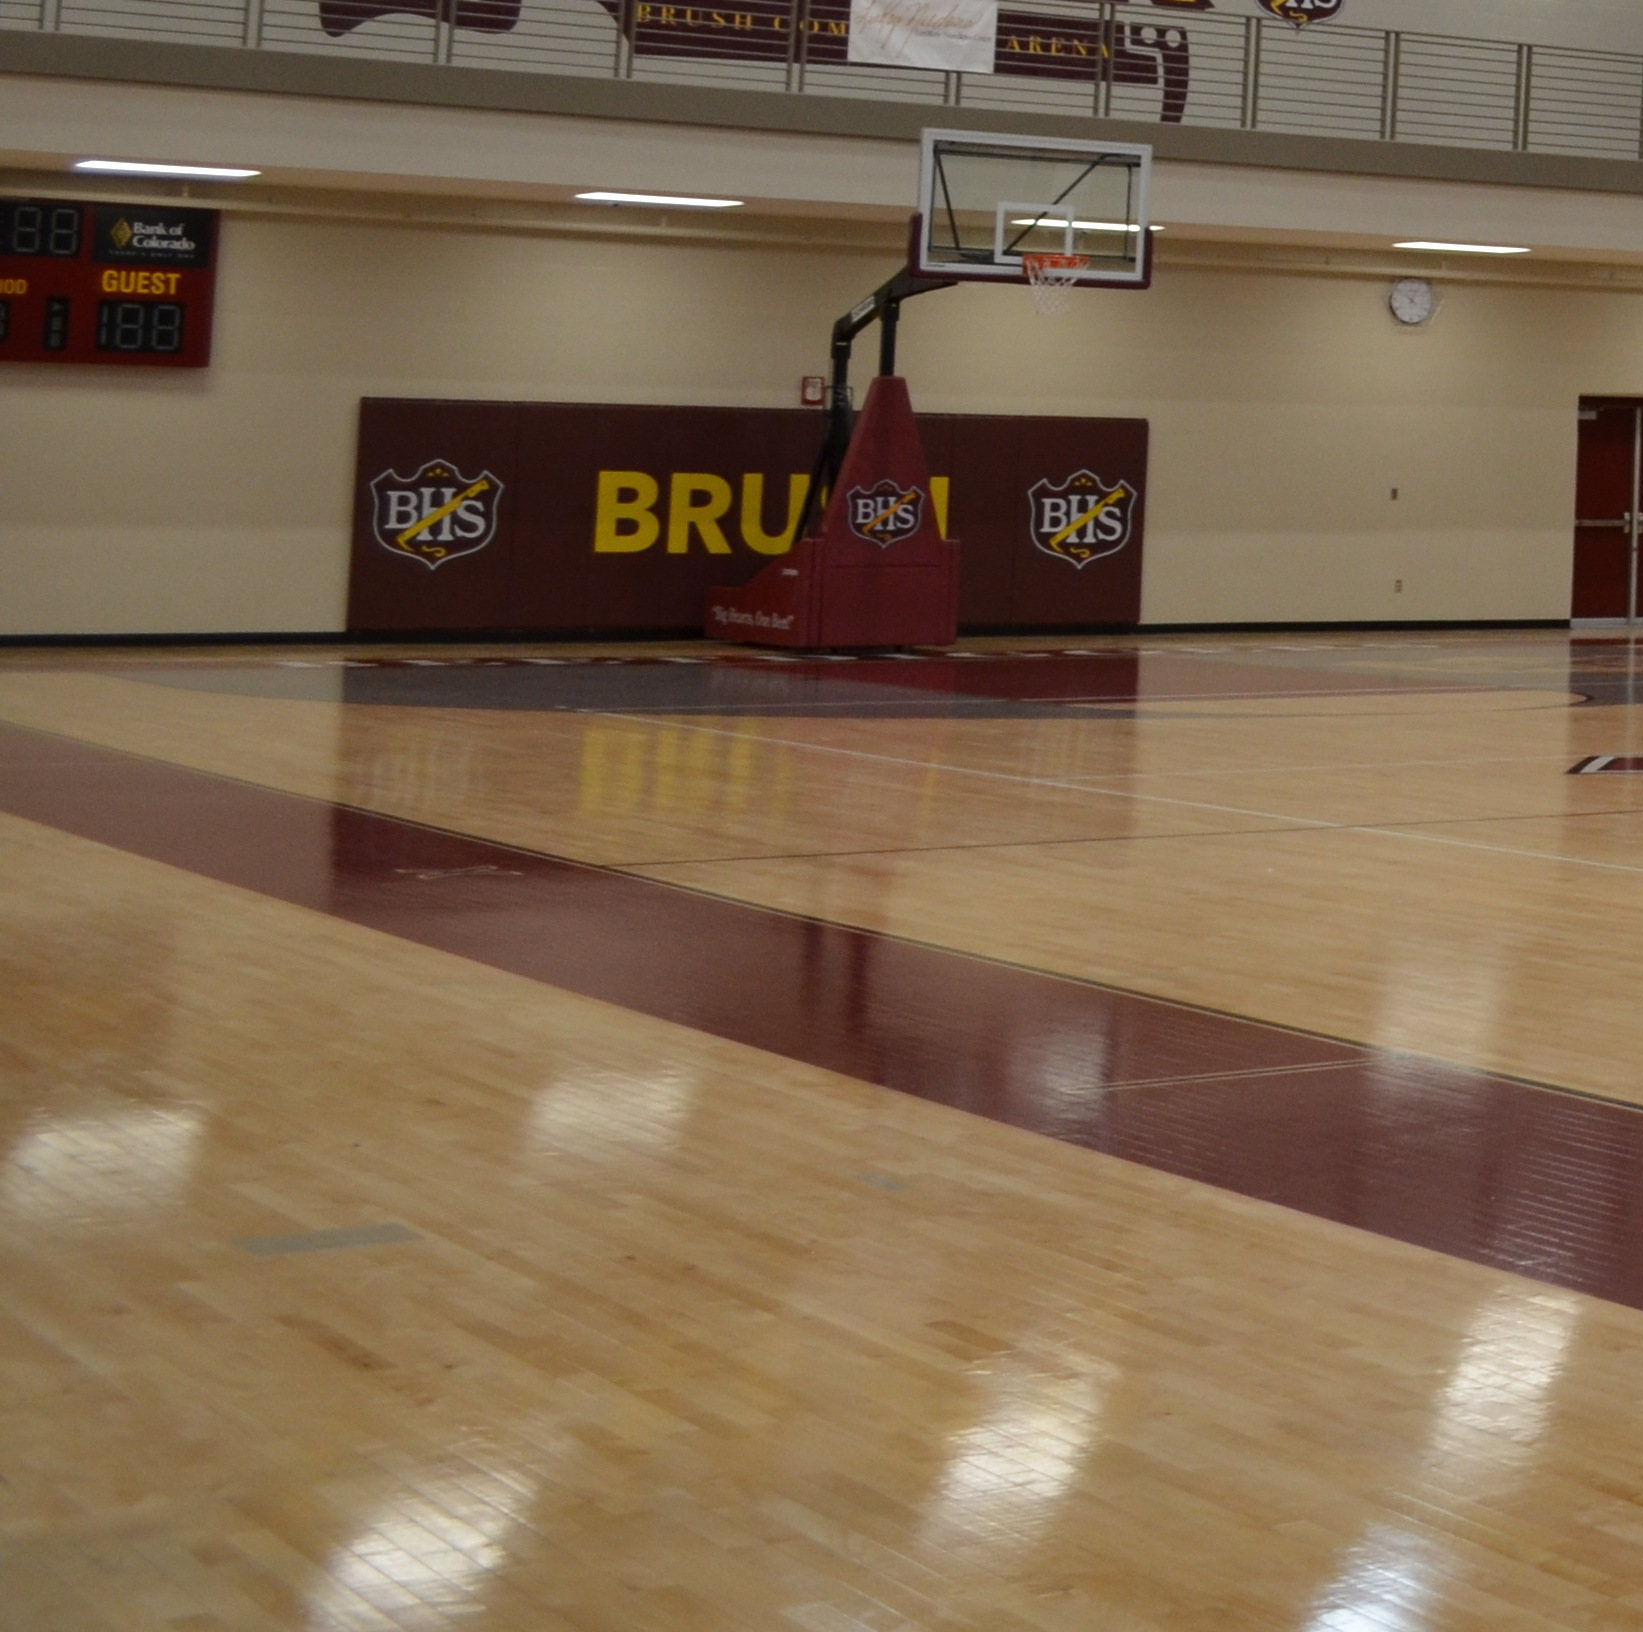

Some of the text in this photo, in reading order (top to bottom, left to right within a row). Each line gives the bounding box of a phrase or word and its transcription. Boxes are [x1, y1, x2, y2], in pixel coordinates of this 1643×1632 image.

[636, 2, 753, 32] BRUSH
[132, 235, 196, 251] Colorado
[133, 221, 186, 236] Bank of
[101, 269, 181, 296] GUEST
[383, 487, 487, 542] BHS
[594, 469, 950, 555] BRU
[854, 496, 916, 531] BHS
[1038, 494, 1123, 544] BHS
